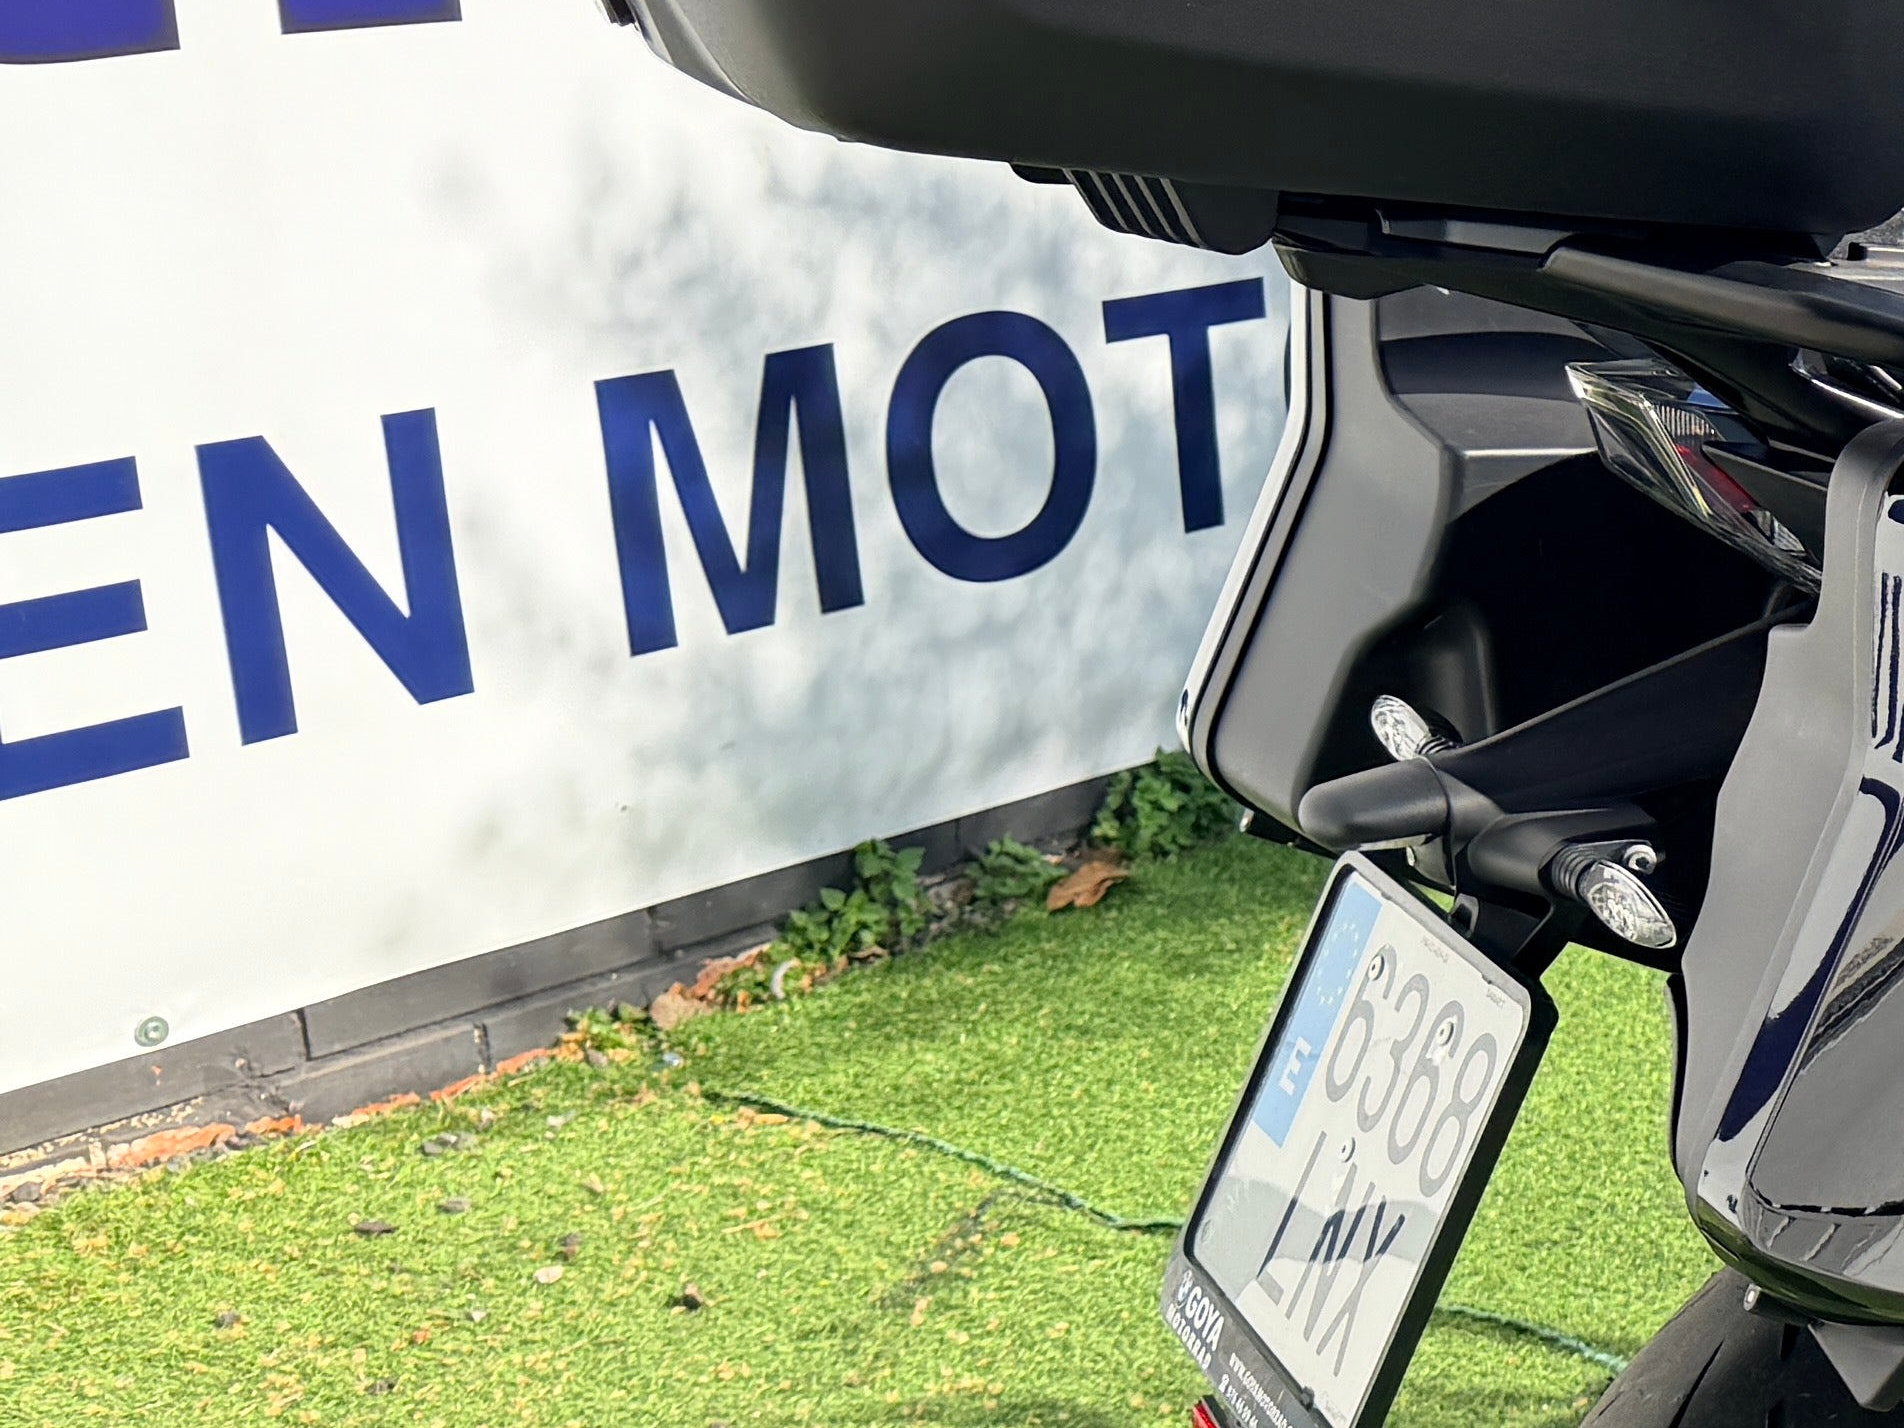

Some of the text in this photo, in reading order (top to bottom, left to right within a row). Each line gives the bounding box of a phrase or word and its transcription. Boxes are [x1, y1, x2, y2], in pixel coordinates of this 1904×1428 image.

[593, 275, 1292, 658] MOT
[1324, 942, 1499, 1199] 6368
[1184, 1285, 1225, 1352] GOYA
[1255, 1129, 1406, 1378] LNX
